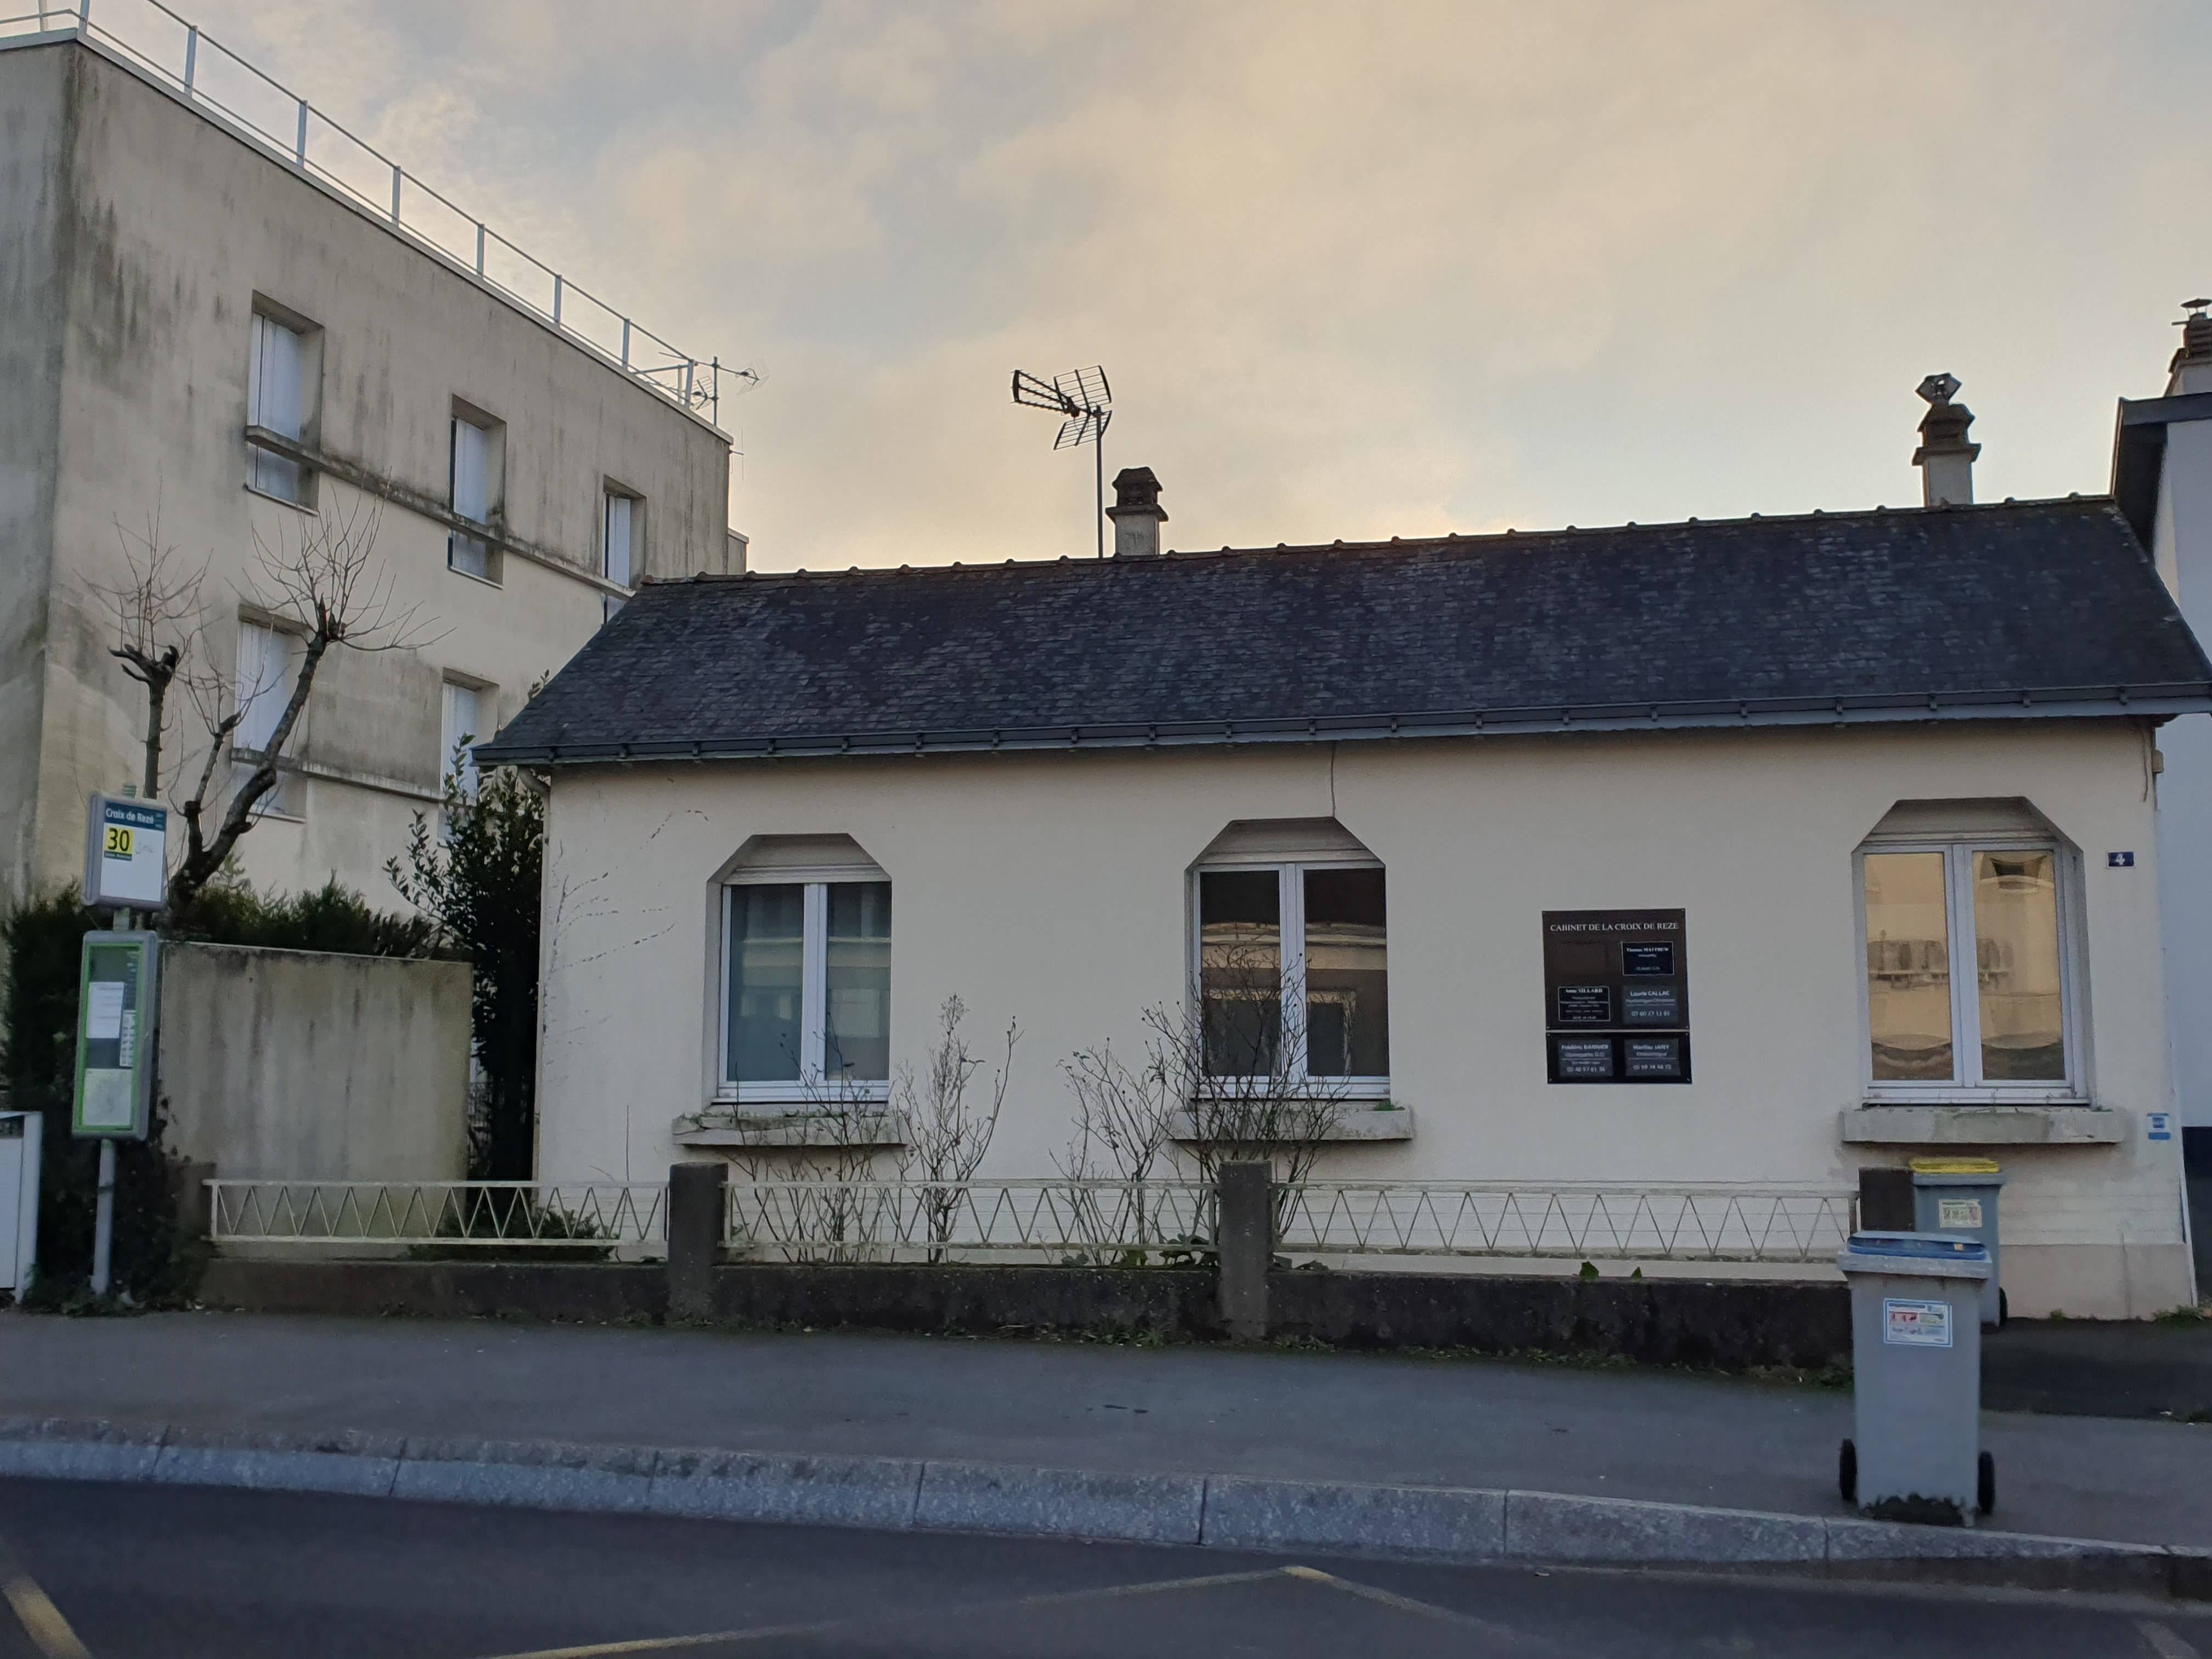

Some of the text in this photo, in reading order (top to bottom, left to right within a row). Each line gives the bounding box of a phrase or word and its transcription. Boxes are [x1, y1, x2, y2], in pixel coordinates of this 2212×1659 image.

[106, 808, 125, 819] Croix
[126, 811, 136, 821] de
[108, 827, 129, 851] 30
[2115, 854, 2125, 865] 4
